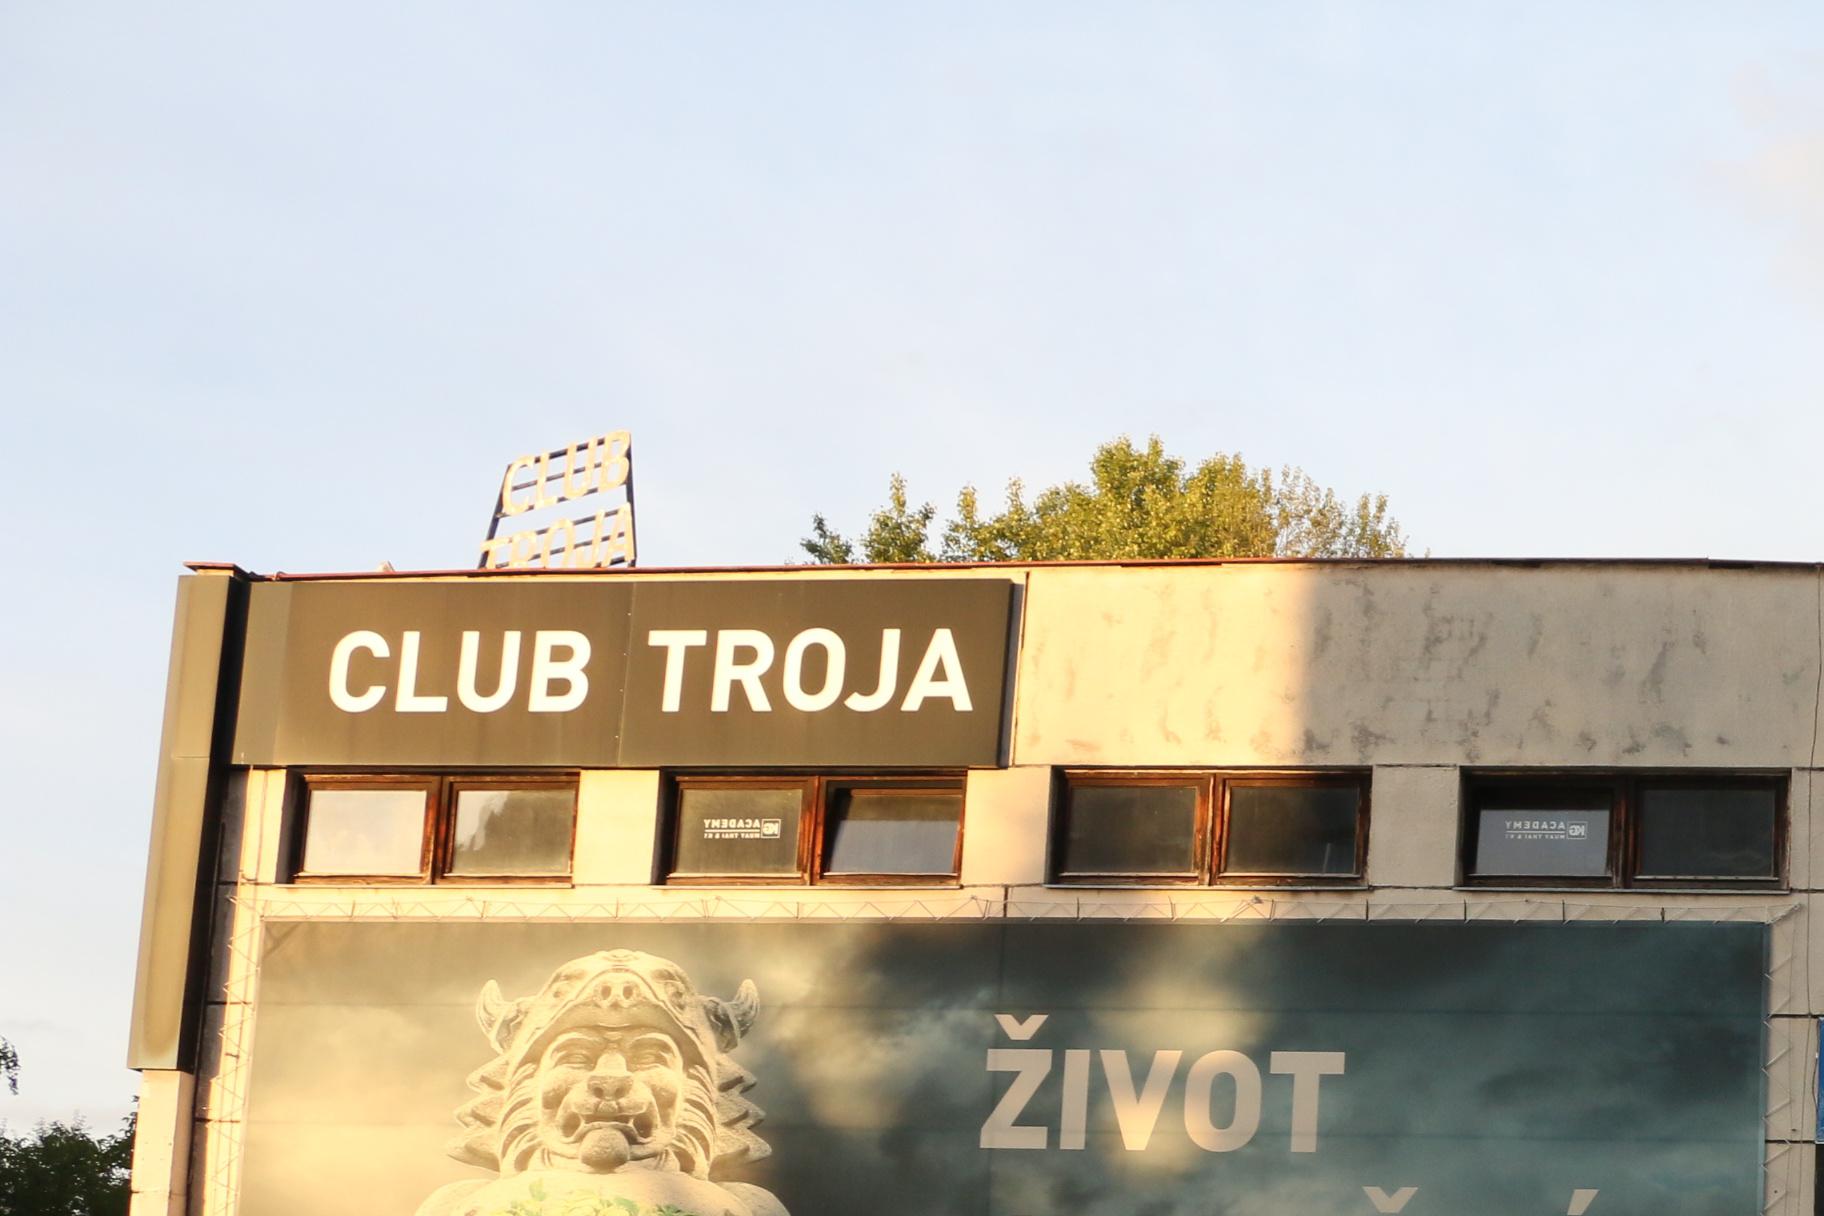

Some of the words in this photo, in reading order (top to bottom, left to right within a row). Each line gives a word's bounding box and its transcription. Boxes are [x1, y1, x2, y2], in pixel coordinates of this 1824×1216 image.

[503, 430, 631, 516] CLUB
[329, 629, 592, 713] CLUB
[648, 627, 973, 713] TROJA
[979, 1014, 1345, 1152] ŽIVOT
